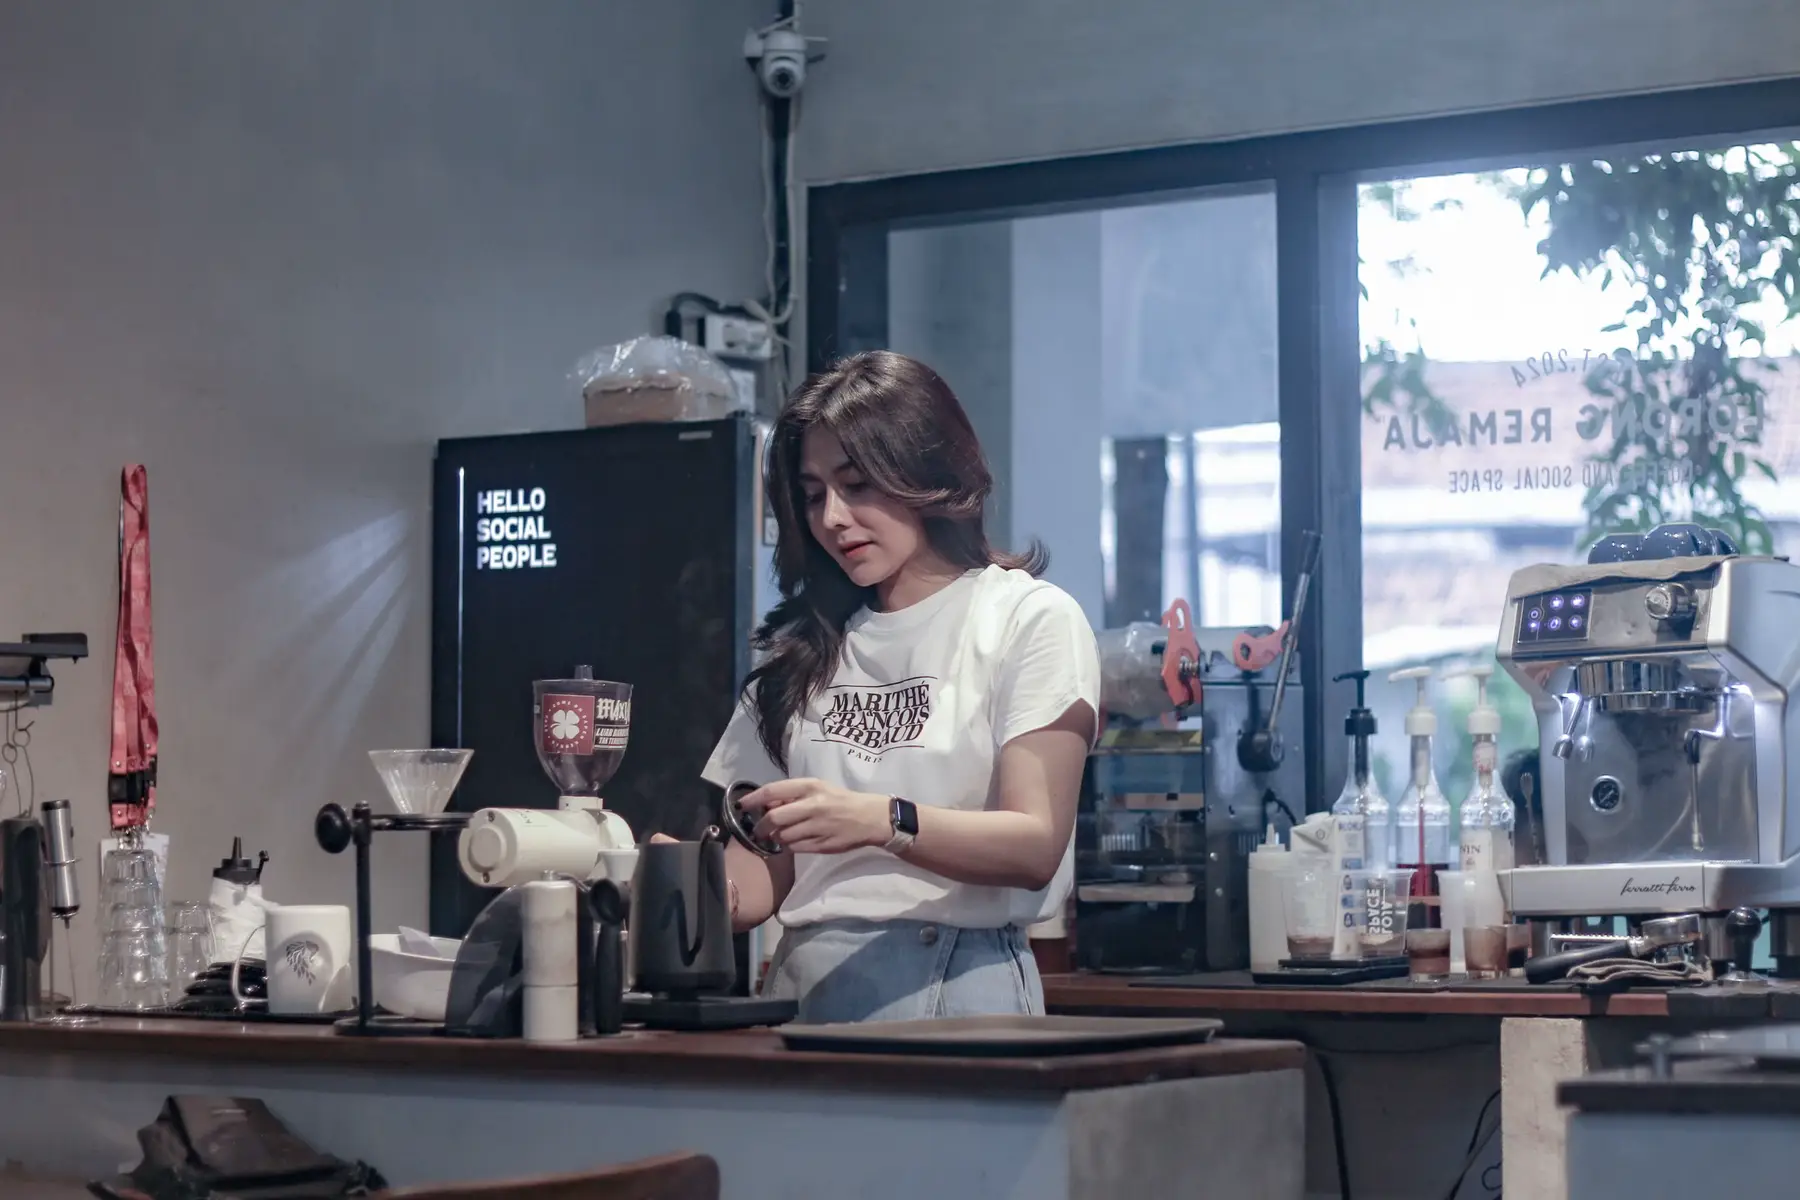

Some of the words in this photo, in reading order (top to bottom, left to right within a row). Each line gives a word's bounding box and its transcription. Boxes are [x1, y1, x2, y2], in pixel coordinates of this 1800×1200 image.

[477, 487, 546, 514] HELLO
[477, 515, 551, 542] SOCIAL
[477, 543, 557, 570] PEOPLE
[831, 680, 930, 712] MARITHÉ
